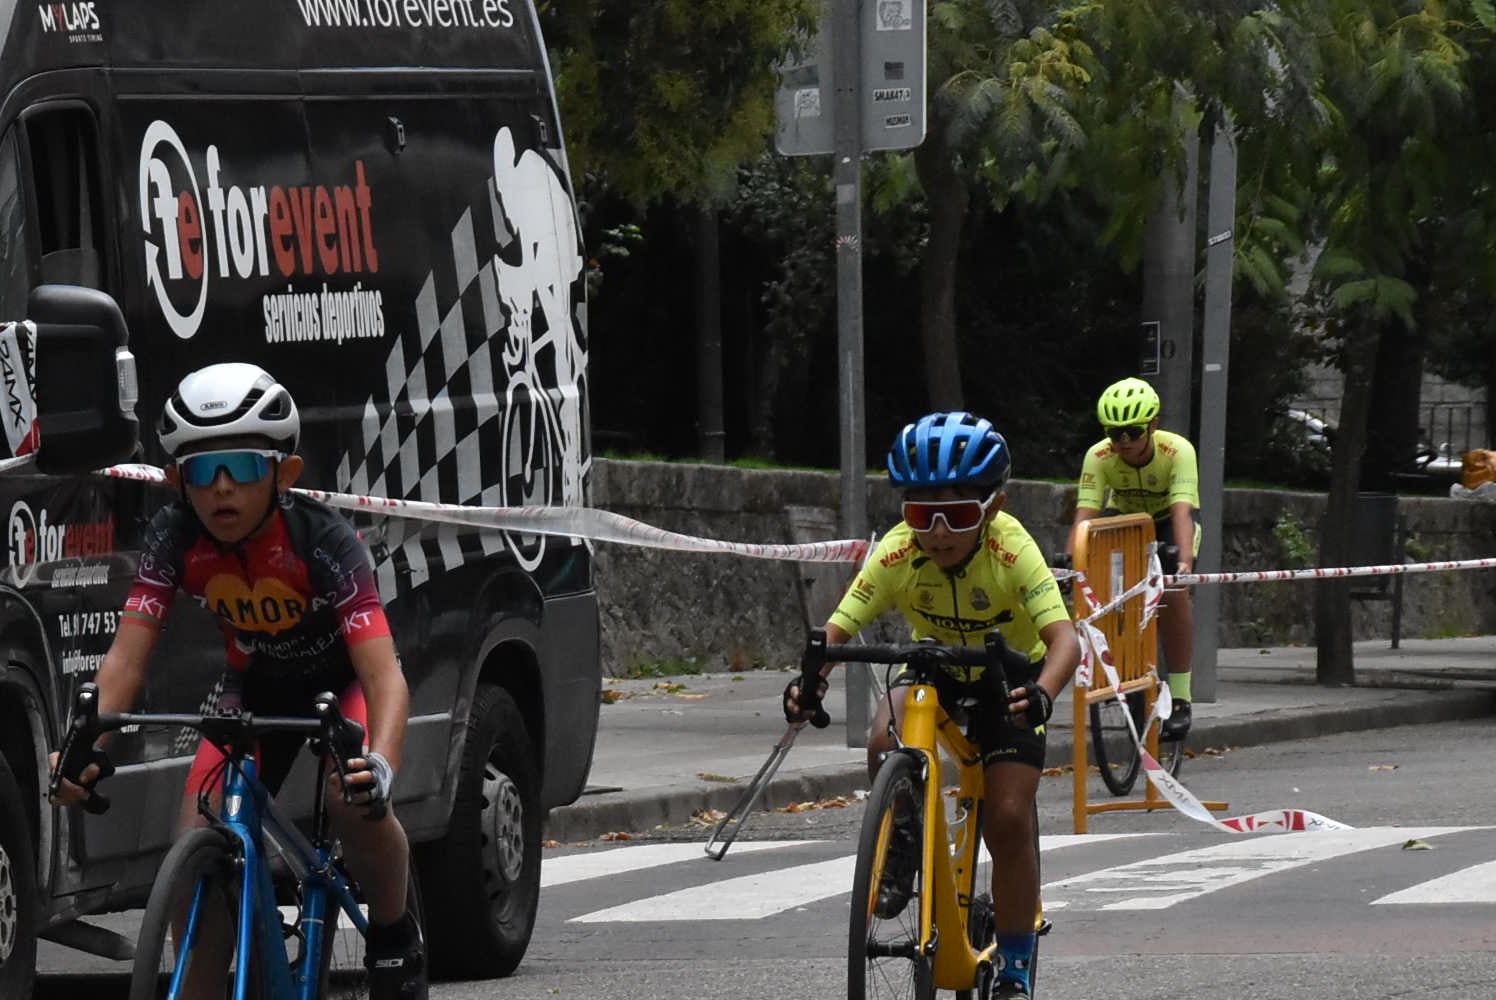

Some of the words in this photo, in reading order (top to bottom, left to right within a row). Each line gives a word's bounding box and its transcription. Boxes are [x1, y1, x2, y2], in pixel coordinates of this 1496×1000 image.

[38, 2, 100, 33] MYLAPS
[206, 144, 379, 280] forevent
[262, 284, 321, 343] servicios
[320, 281, 385, 346] deportivos
[81, 611, 101, 636] 747
[104, 610, 117, 634] 53
